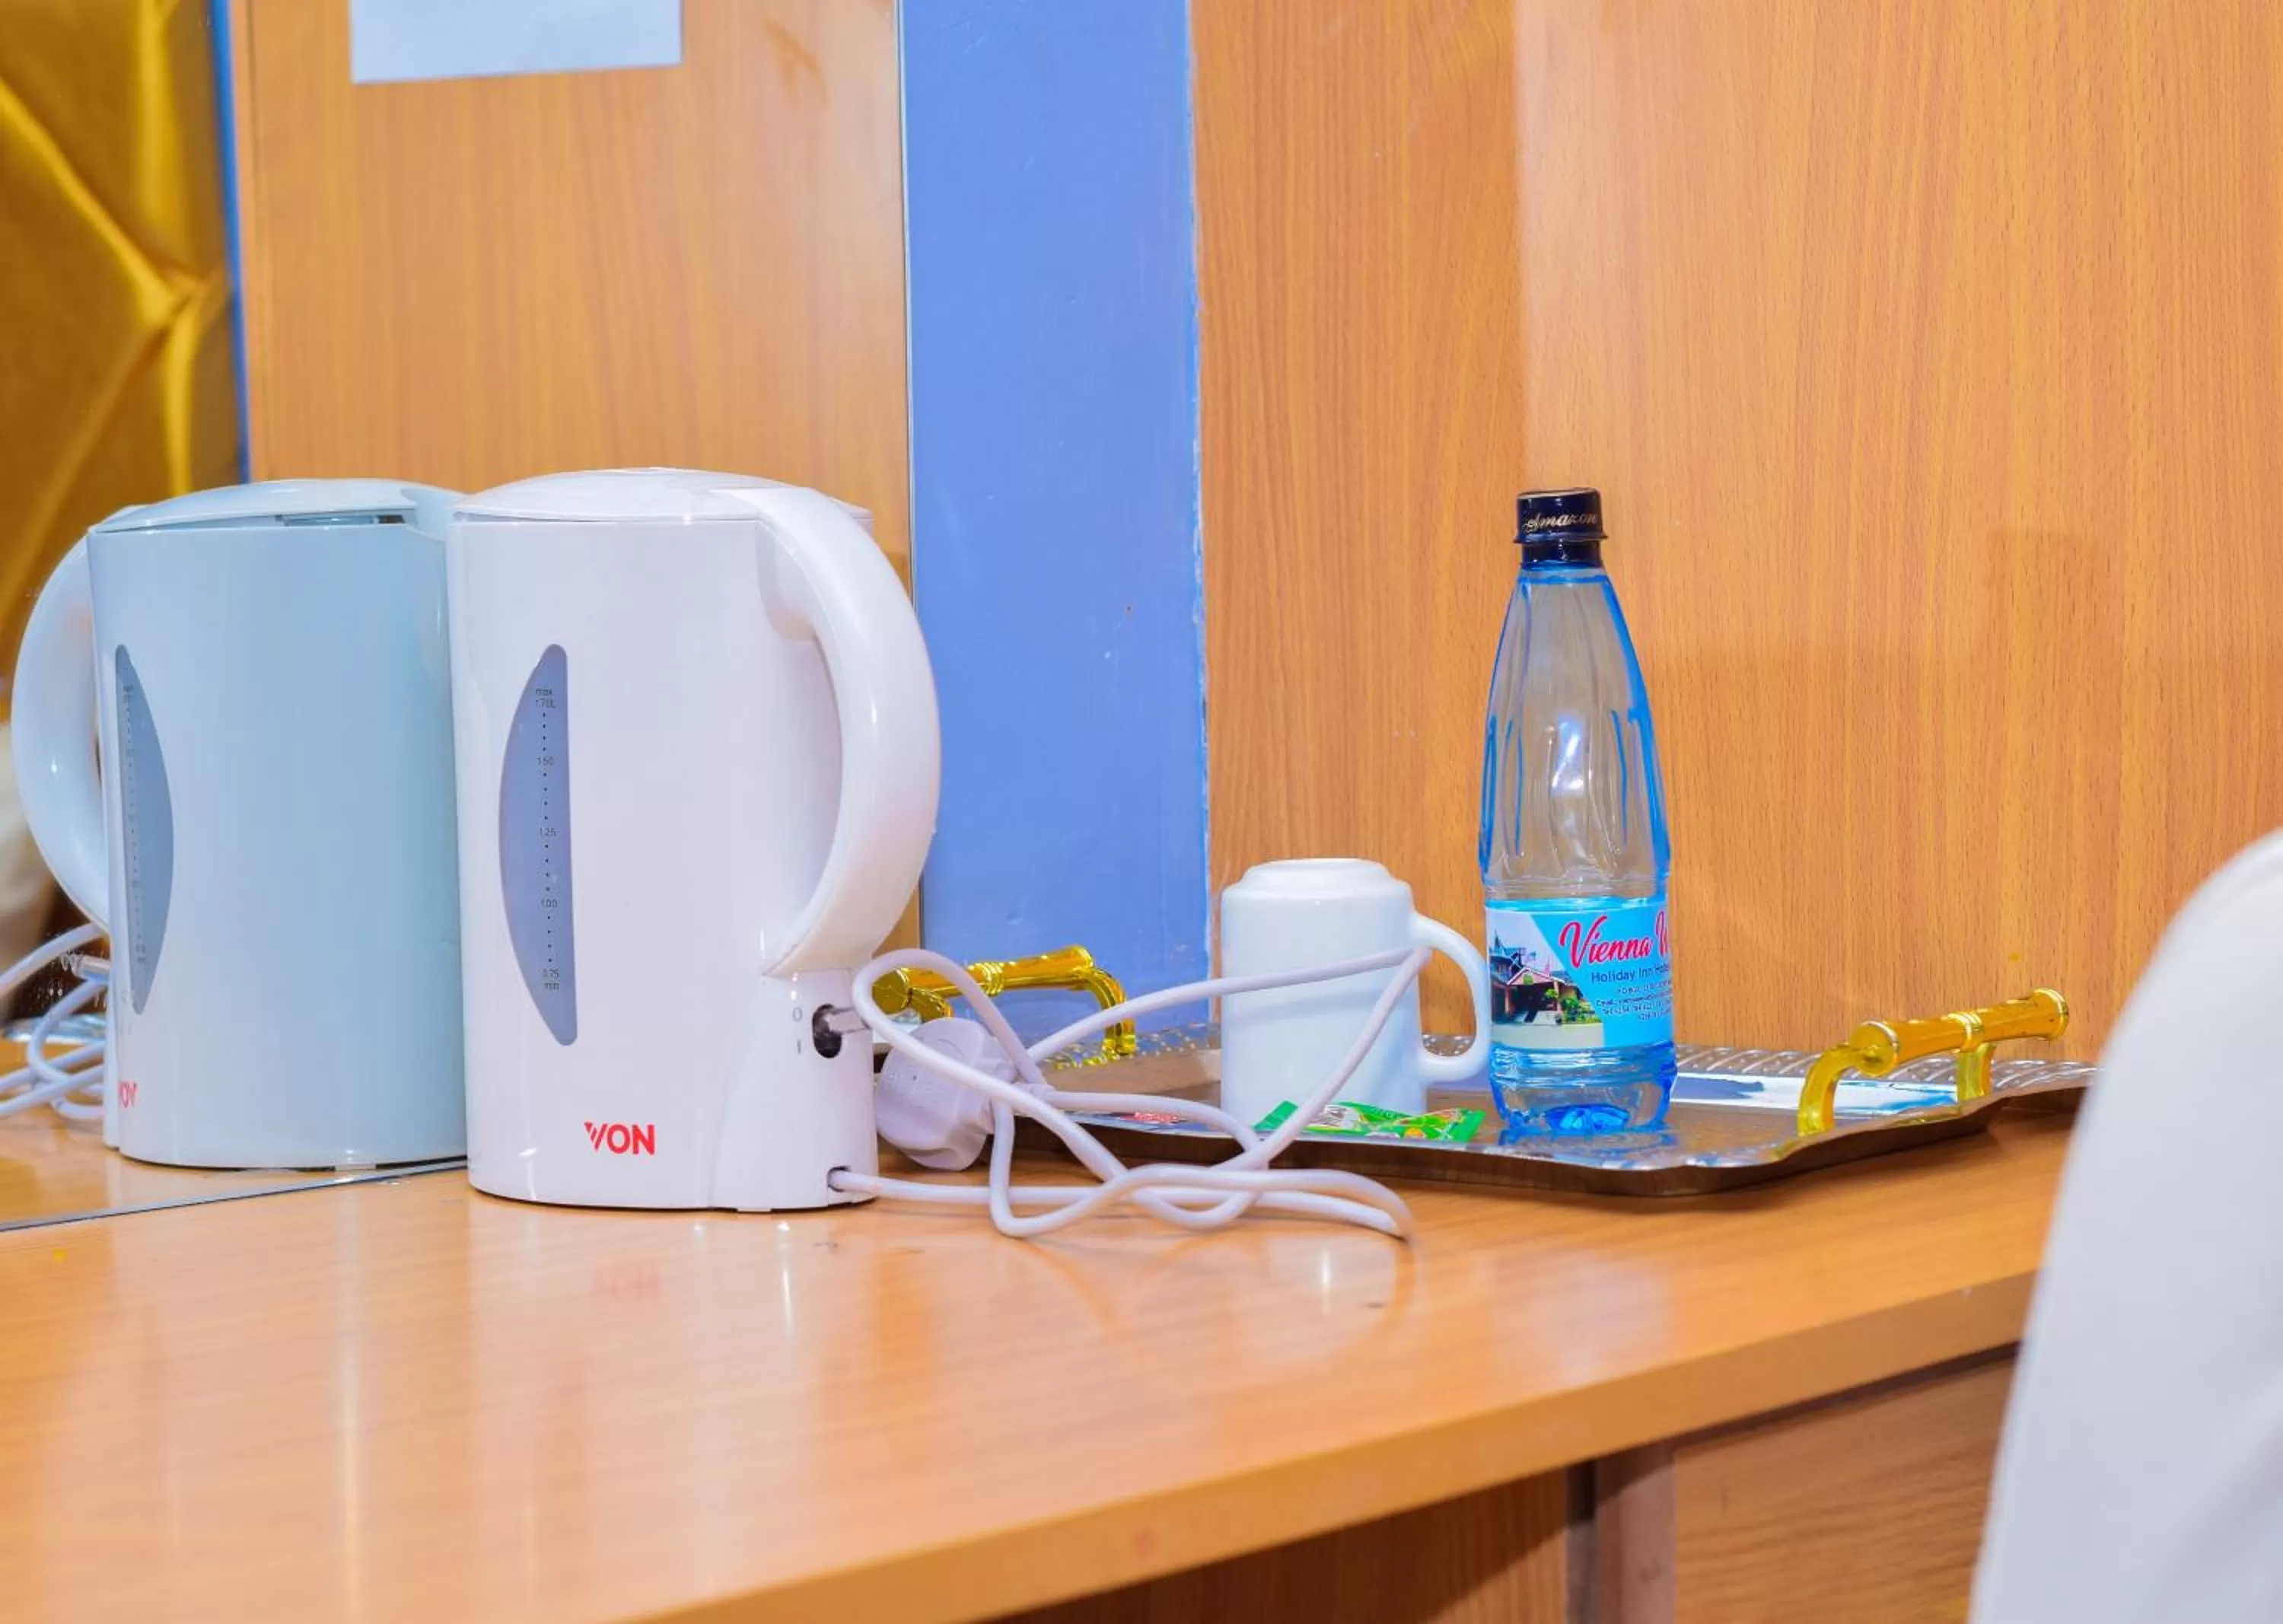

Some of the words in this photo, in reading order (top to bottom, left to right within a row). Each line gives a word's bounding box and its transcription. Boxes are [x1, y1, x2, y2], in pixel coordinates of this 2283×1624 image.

[1559, 915, 1651, 968] Vienna
[1591, 970, 1635, 983] Holiday
[1638, 966, 1653, 978] Inn
[584, 1121, 656, 1156] VON
